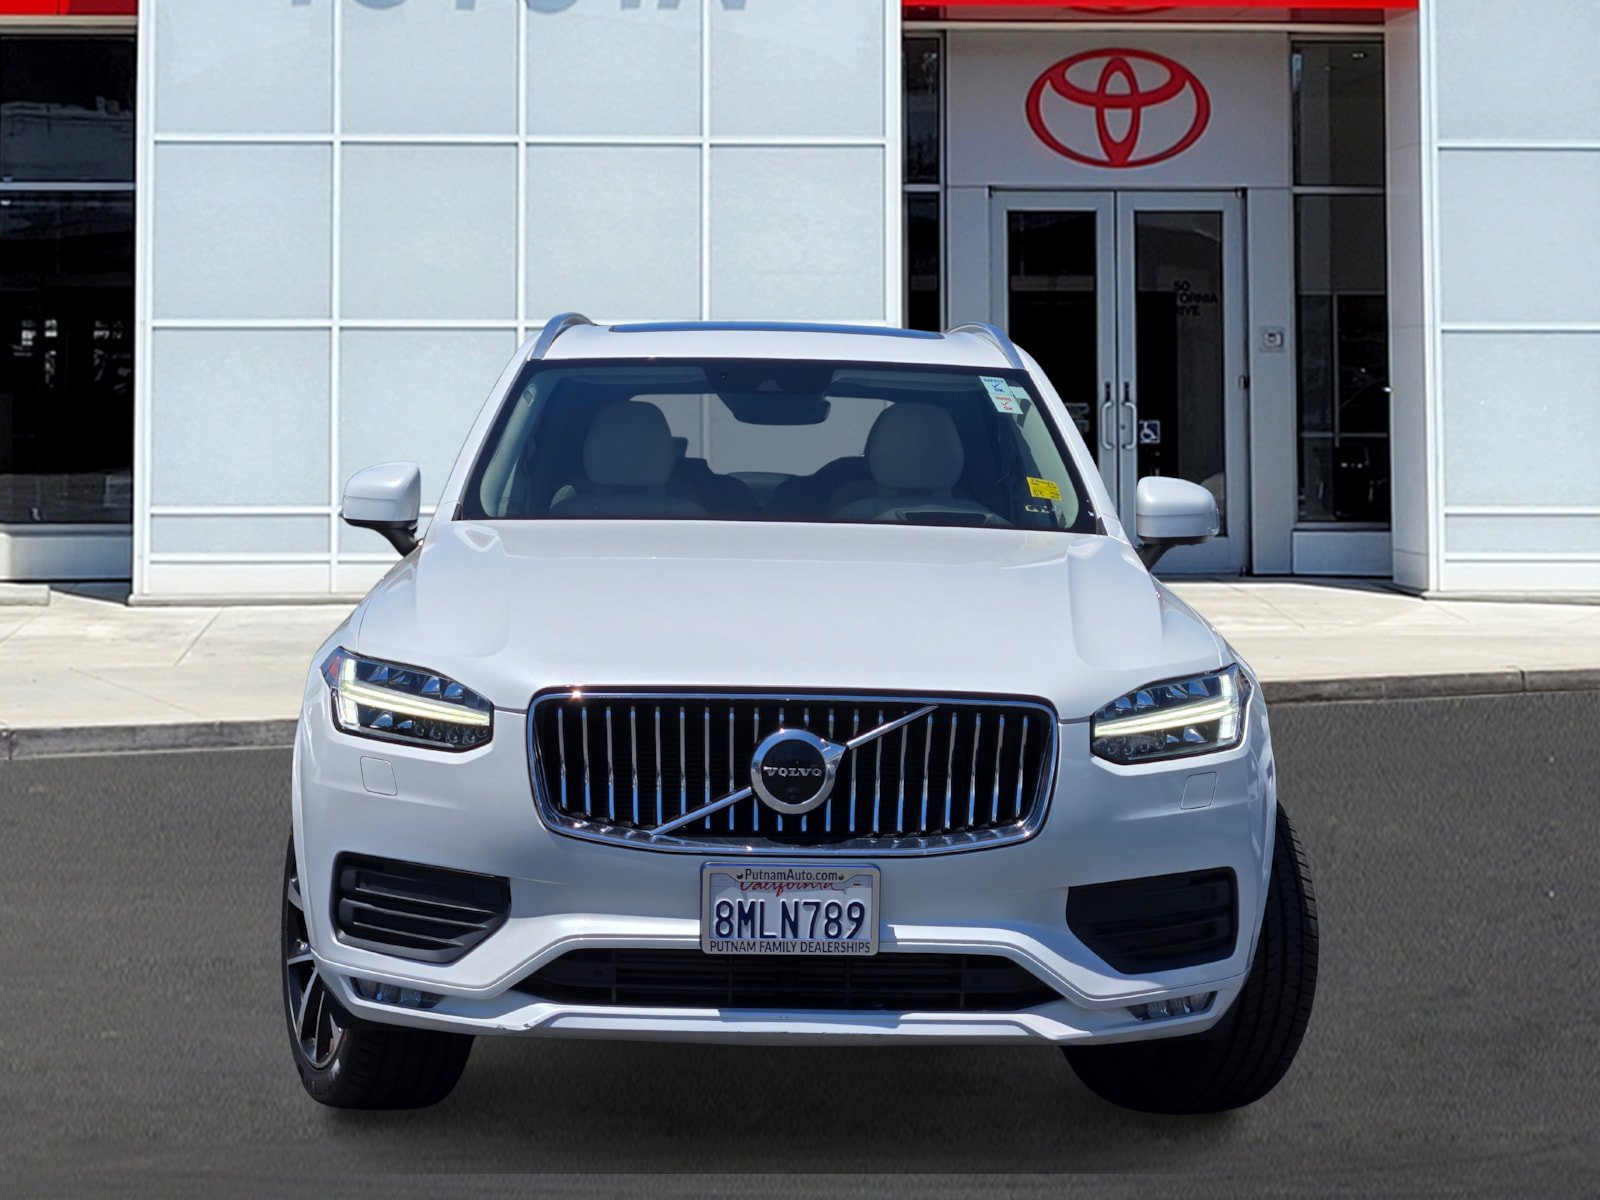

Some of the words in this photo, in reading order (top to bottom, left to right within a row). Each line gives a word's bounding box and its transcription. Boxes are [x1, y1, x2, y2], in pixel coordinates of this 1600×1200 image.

[764, 766, 822, 777] VOLVO
[745, 869, 838, 881] PutnamAuto.com
[715, 900, 865, 940] 8MLN789
[710, 941, 756, 952] PUTNAM
[759, 941, 798, 953] FAMILY
[800, 942, 871, 953] DEALERSHIPS
